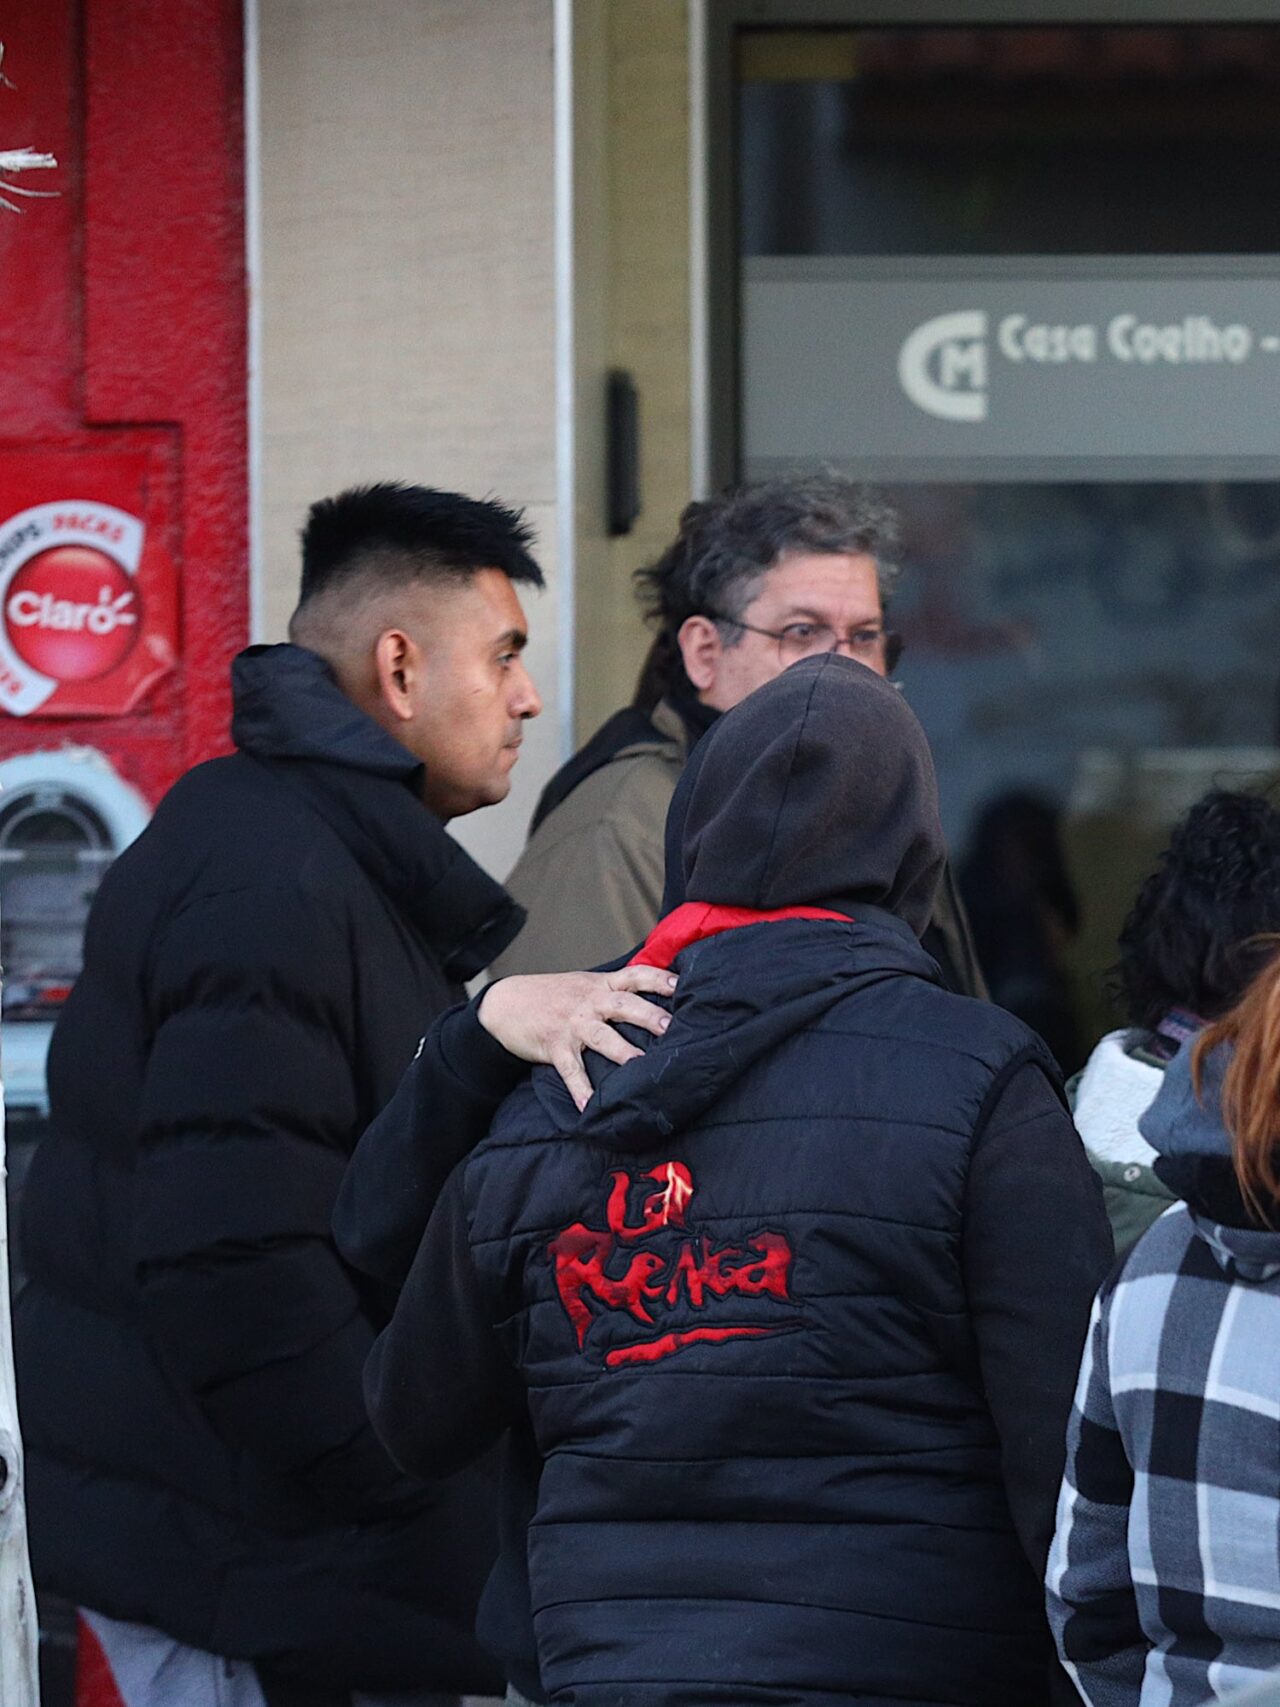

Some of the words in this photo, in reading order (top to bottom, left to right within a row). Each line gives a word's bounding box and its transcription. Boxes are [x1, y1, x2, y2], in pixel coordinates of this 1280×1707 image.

[998, 315, 1095, 362] Casa
[1108, 314, 1252, 363] Coelho
[8, 588, 128, 635] Claro
[607, 1161, 694, 1241] La
